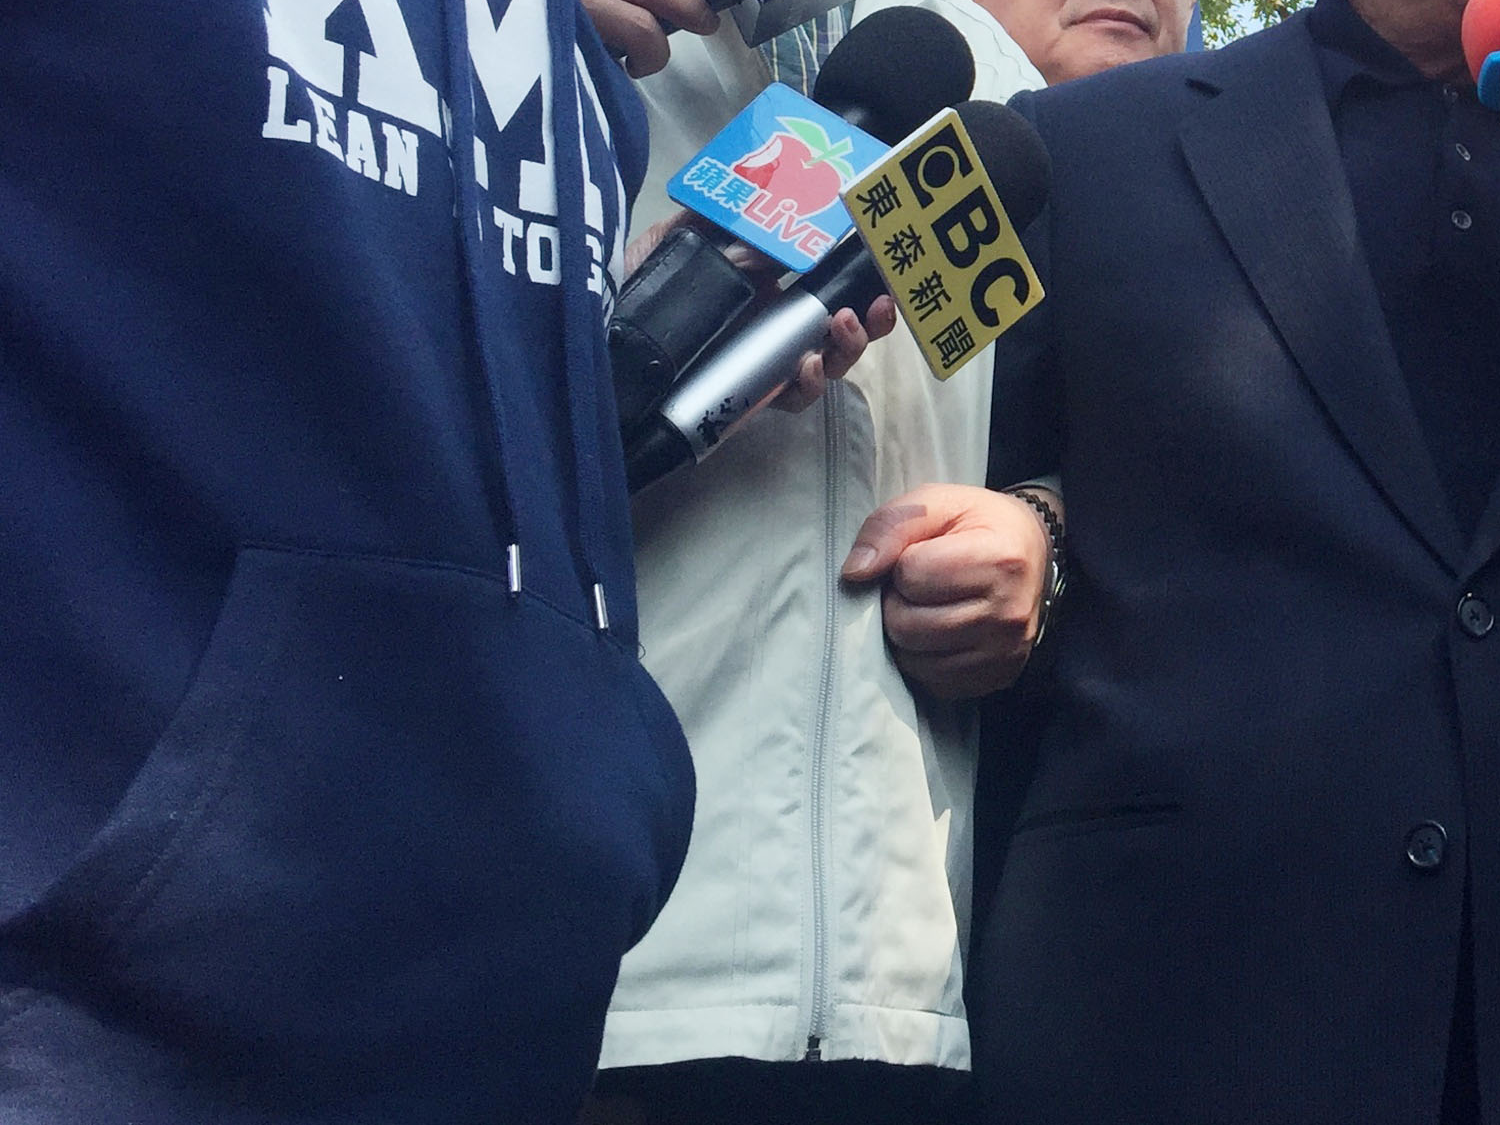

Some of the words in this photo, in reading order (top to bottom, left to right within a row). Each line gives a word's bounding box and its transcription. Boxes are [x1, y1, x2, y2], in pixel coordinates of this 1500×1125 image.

[262, 65, 419, 197] LEAN
[493, 206, 562, 286] TO
[855, 173, 977, 370] 東森新聞
